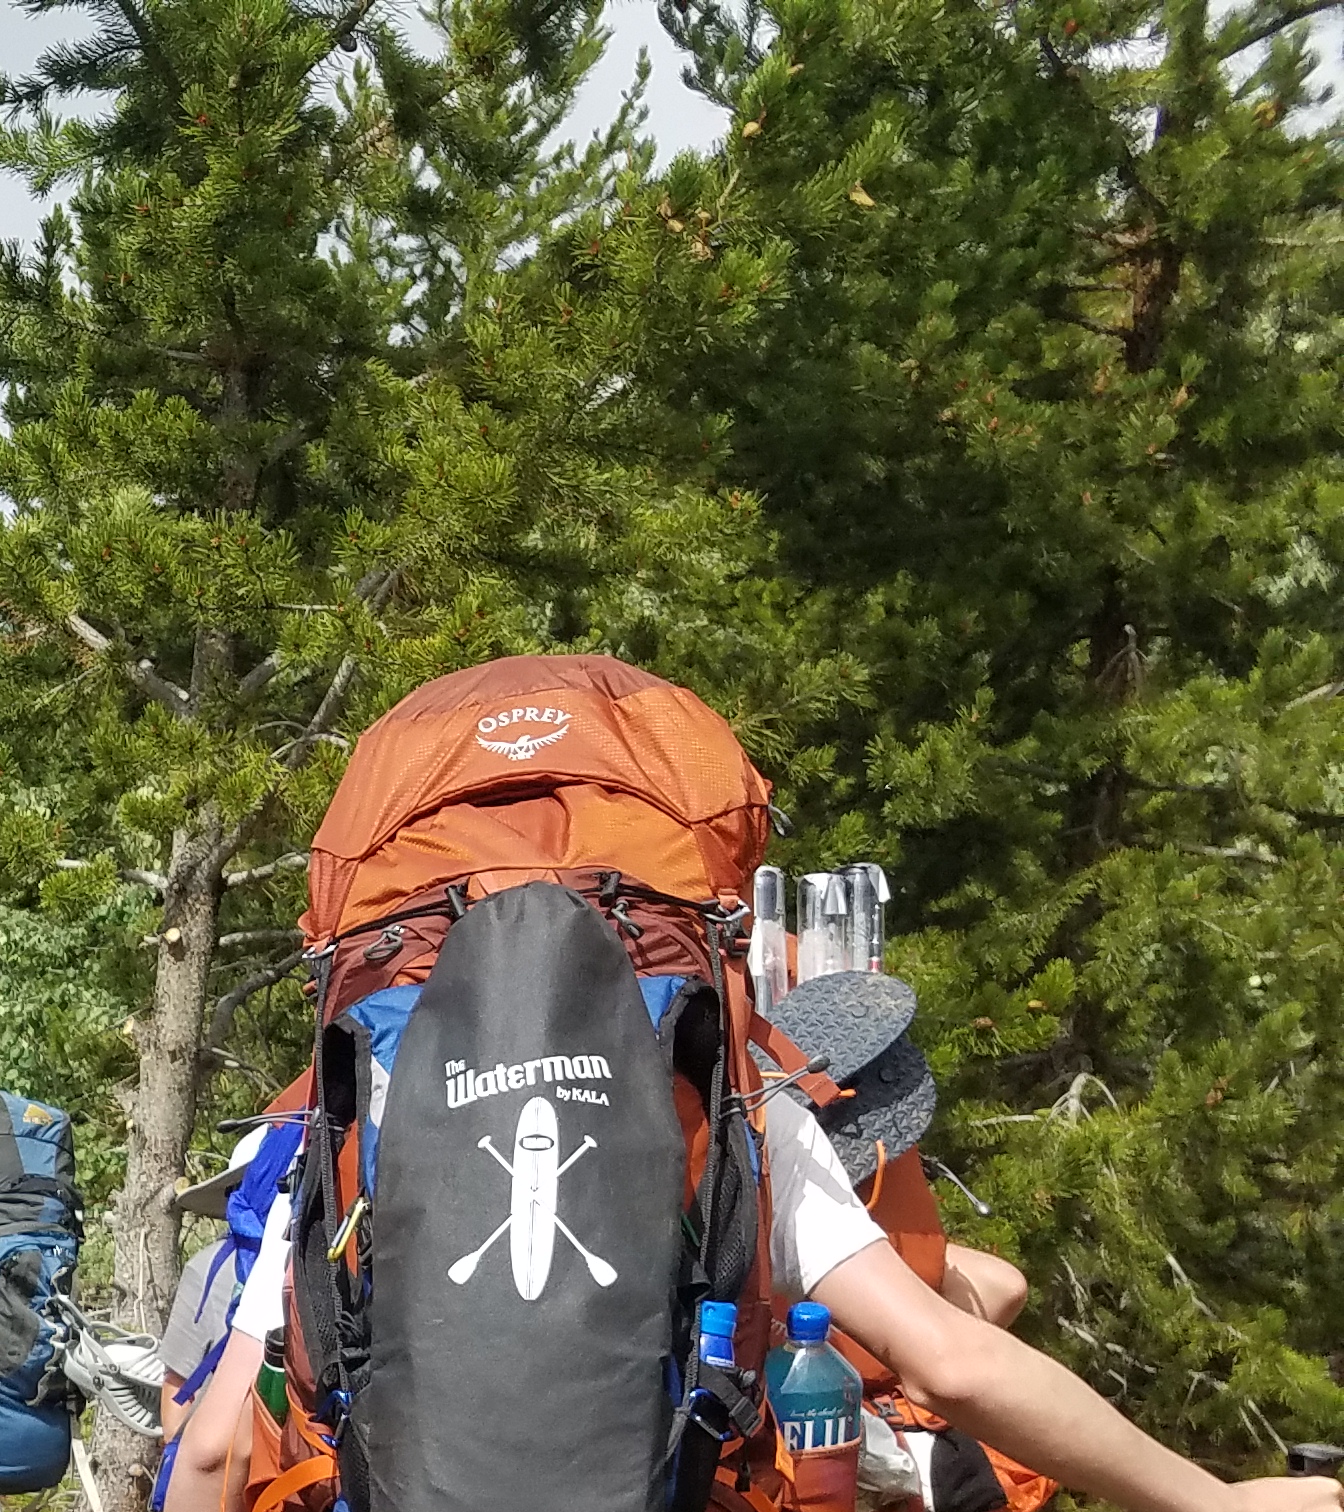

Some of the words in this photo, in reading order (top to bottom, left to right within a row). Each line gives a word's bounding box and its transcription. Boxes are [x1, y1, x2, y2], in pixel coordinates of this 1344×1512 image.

[478, 707, 572, 733] OSPREY
[445, 1060, 466, 1077] The
[446, 1055, 612, 1109] Waterman
[556, 1086, 571, 1101] by
[571, 1087, 610, 1107] KALA
